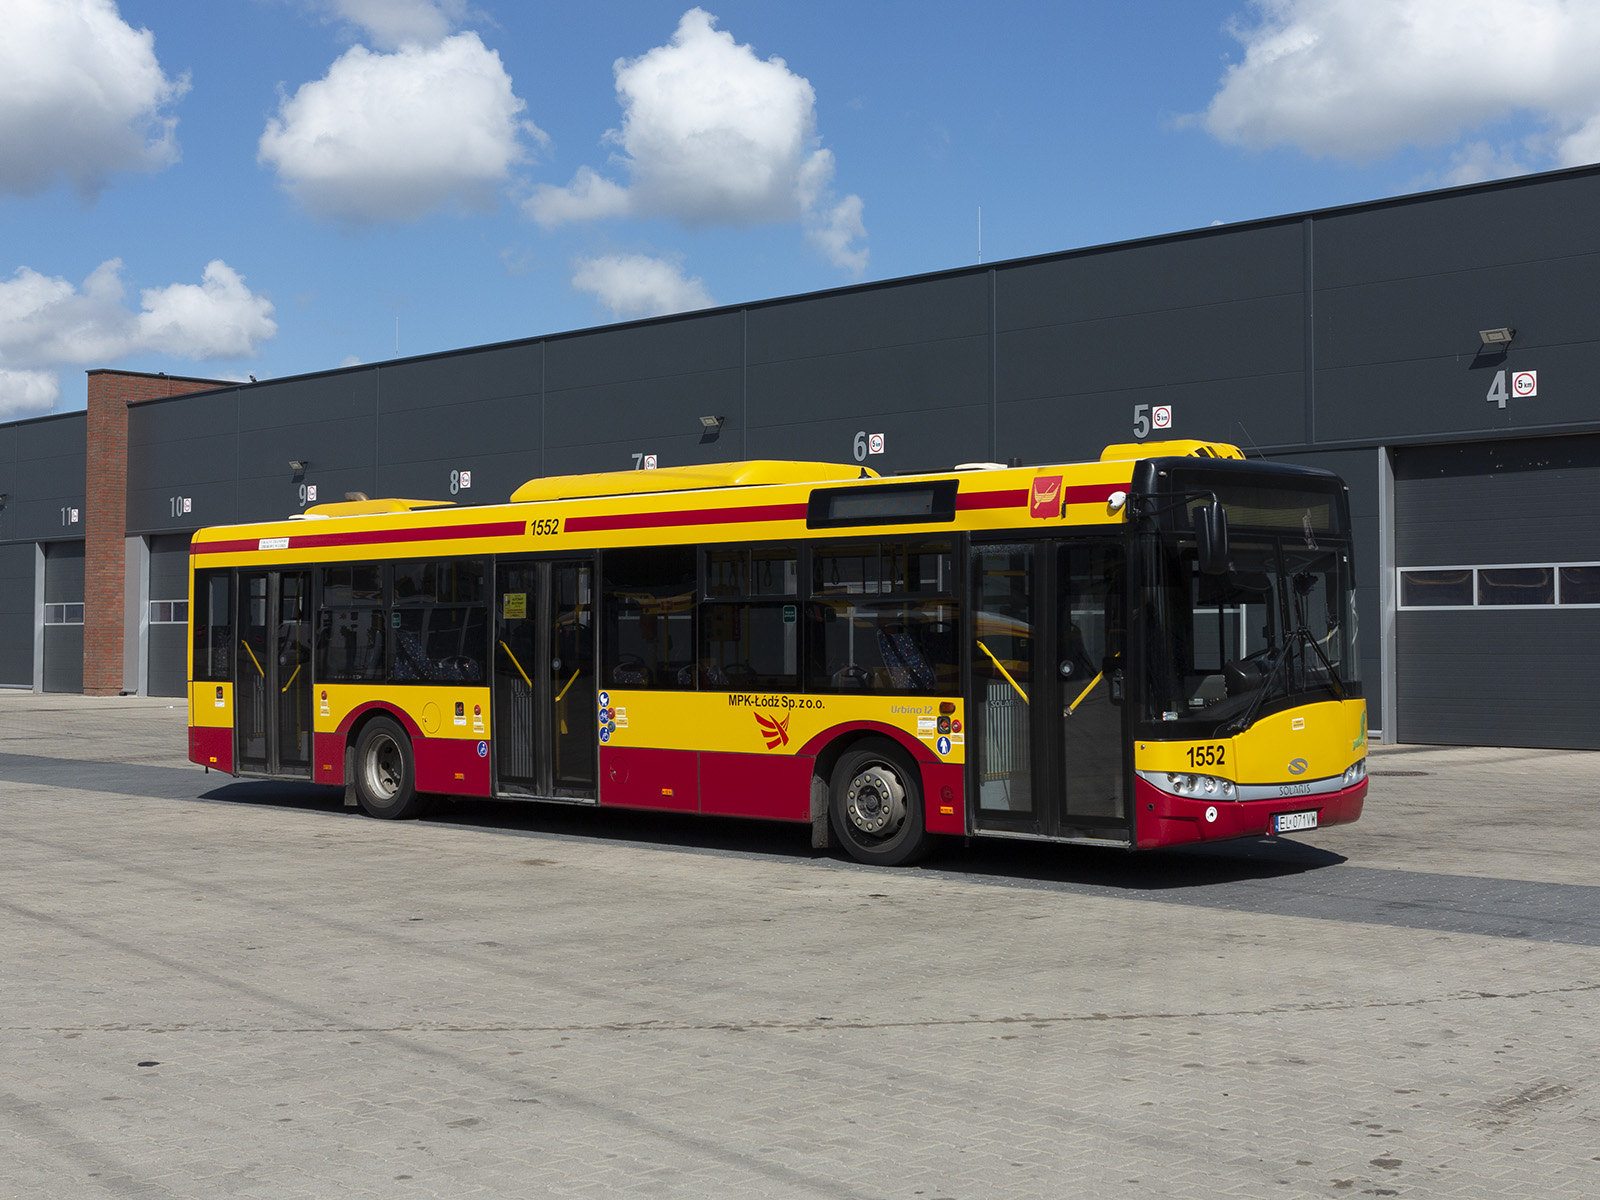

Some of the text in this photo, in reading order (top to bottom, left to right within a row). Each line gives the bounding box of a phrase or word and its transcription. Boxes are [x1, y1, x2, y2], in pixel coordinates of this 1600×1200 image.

[1487, 370, 1509, 409] 4
[1517, 379, 1523, 389] 5
[1133, 403, 1150, 438] 5
[1156, 412, 1161, 421] 5
[854, 431, 867, 462] 6
[632, 453, 644, 470] 7
[450, 469, 459, 495] 8
[299, 484, 307, 507] 9
[170, 495, 183, 518] 10
[61, 507, 72, 527] 11
[530, 518, 560, 536] 1552
[728, 694, 825, 711] MPK-Łódź Sp. z o.o.
[890, 704, 933, 715] Urbino 12
[1187, 744, 1225, 768] 1552
[1279, 783, 1311, 796] SOLARIS
